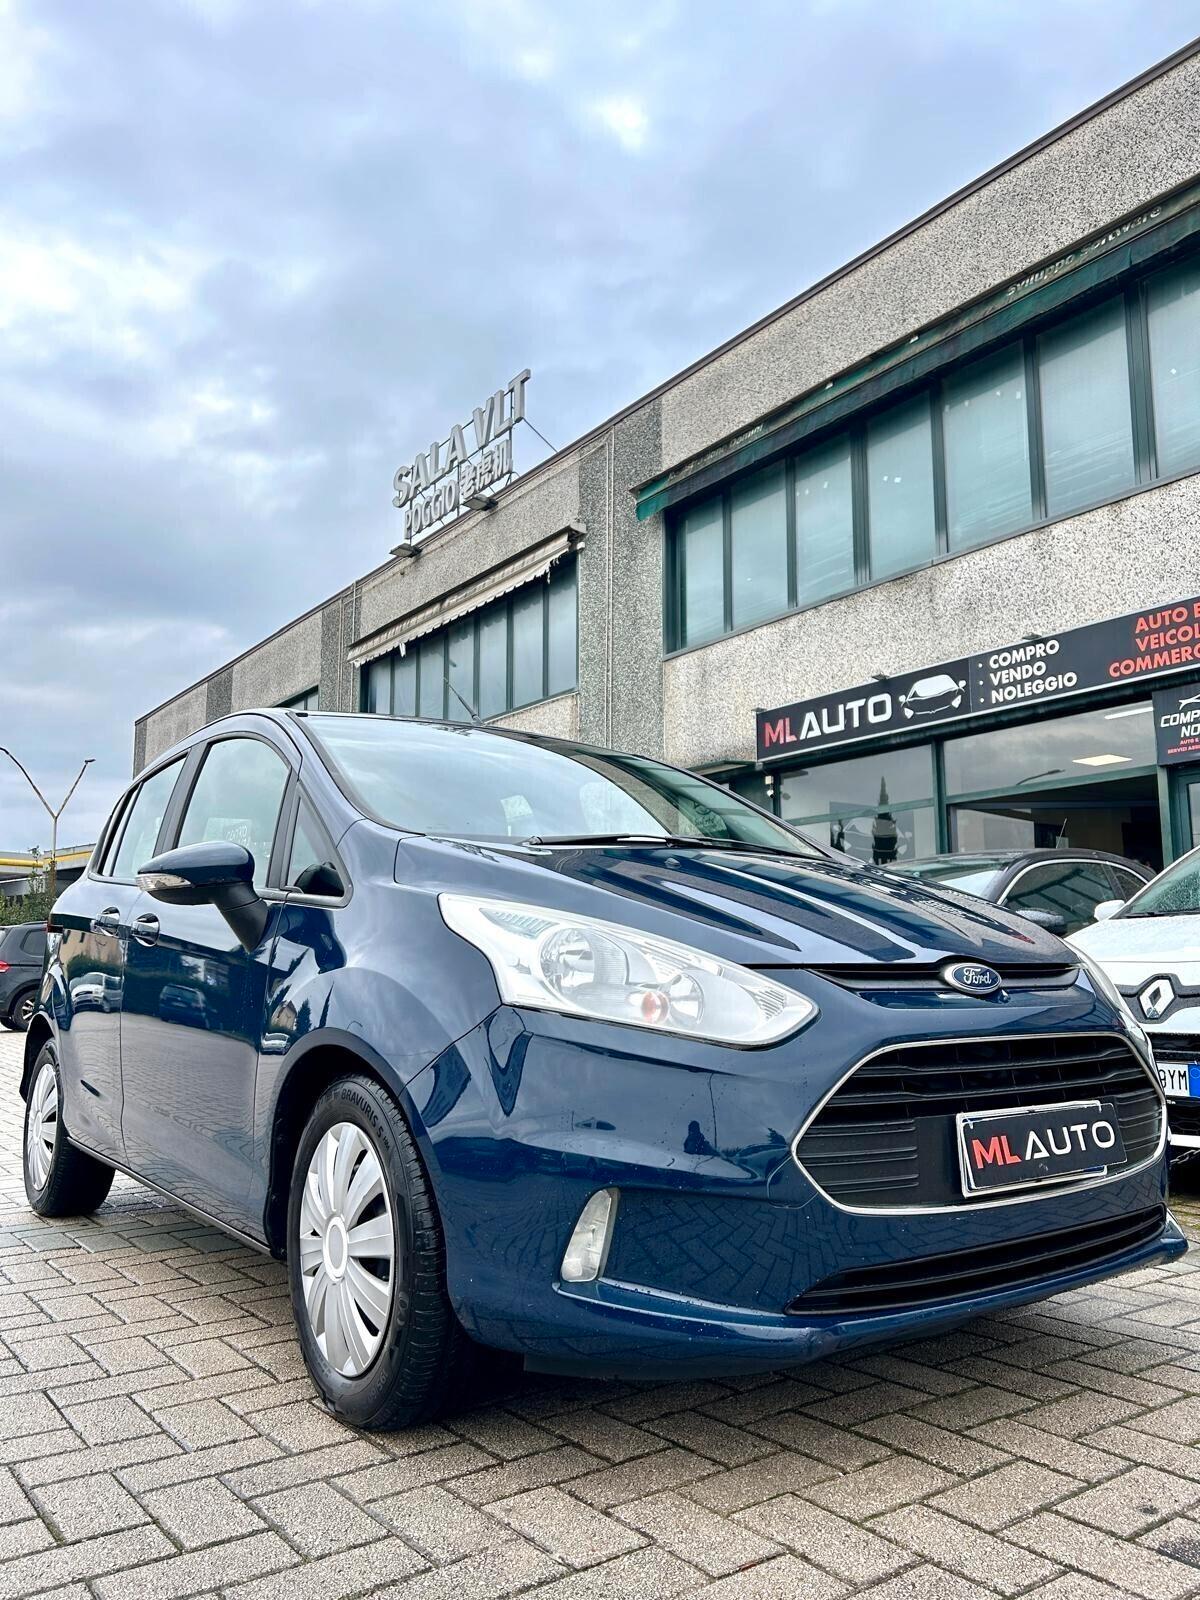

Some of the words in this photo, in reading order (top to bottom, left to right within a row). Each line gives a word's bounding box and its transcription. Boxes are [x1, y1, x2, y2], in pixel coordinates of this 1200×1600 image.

[392, 423, 468, 509] SALA
[472, 368, 531, 449] VLT
[404, 479, 459, 540] POGGIO
[1135, 606, 1188, 634] AUTO
[989, 639, 1060, 669] COMPRO
[989, 660, 1047, 687] VENDO
[991, 671, 1078, 704] NOLEGGIO
[963, 967, 992, 985] Ford
[341, 1088, 379, 1128] BRAVURIS
